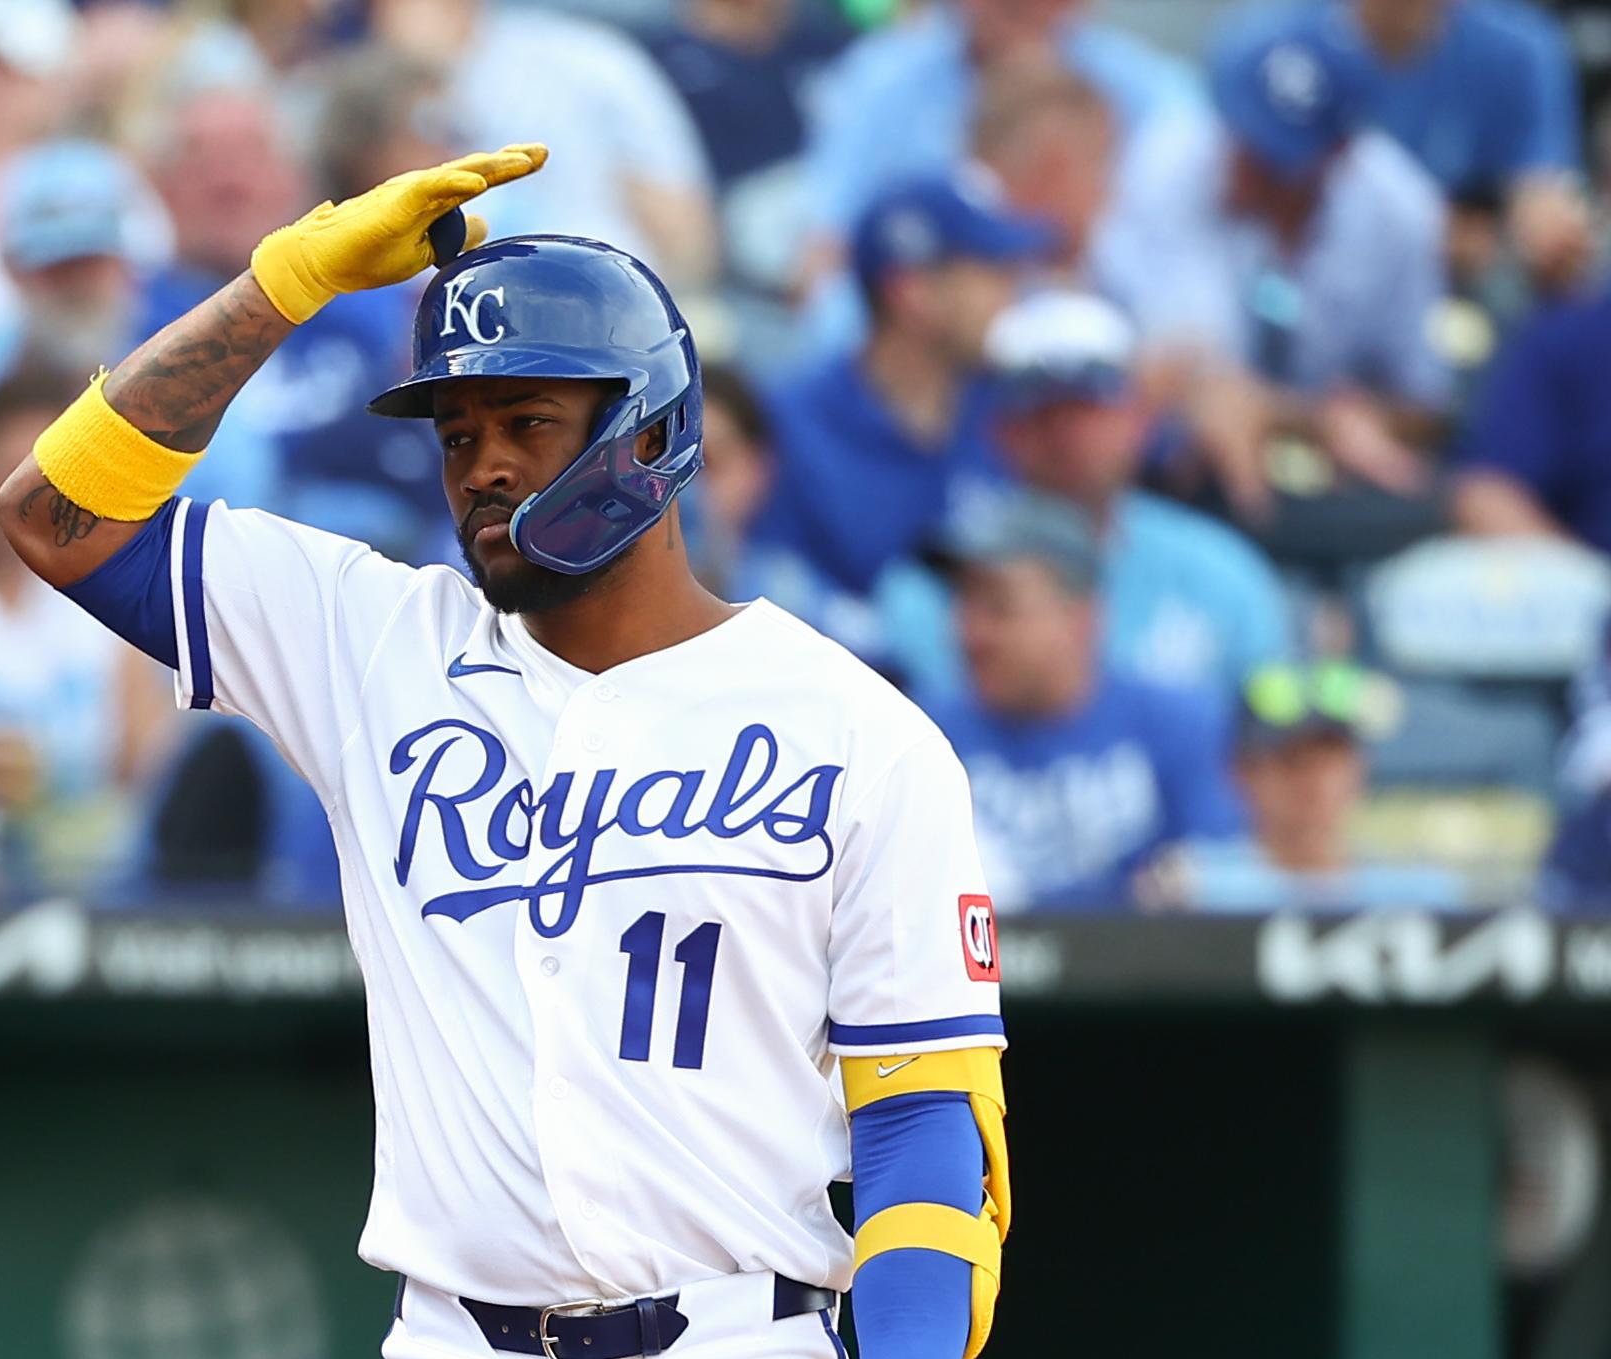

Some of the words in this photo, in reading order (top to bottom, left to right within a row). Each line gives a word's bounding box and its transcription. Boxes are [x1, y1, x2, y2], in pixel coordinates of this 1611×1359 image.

[439, 276, 505, 345] KC
[389, 717, 845, 940] Royals
[618, 910, 722, 1071] 11
[965, 905, 993, 969] QT
